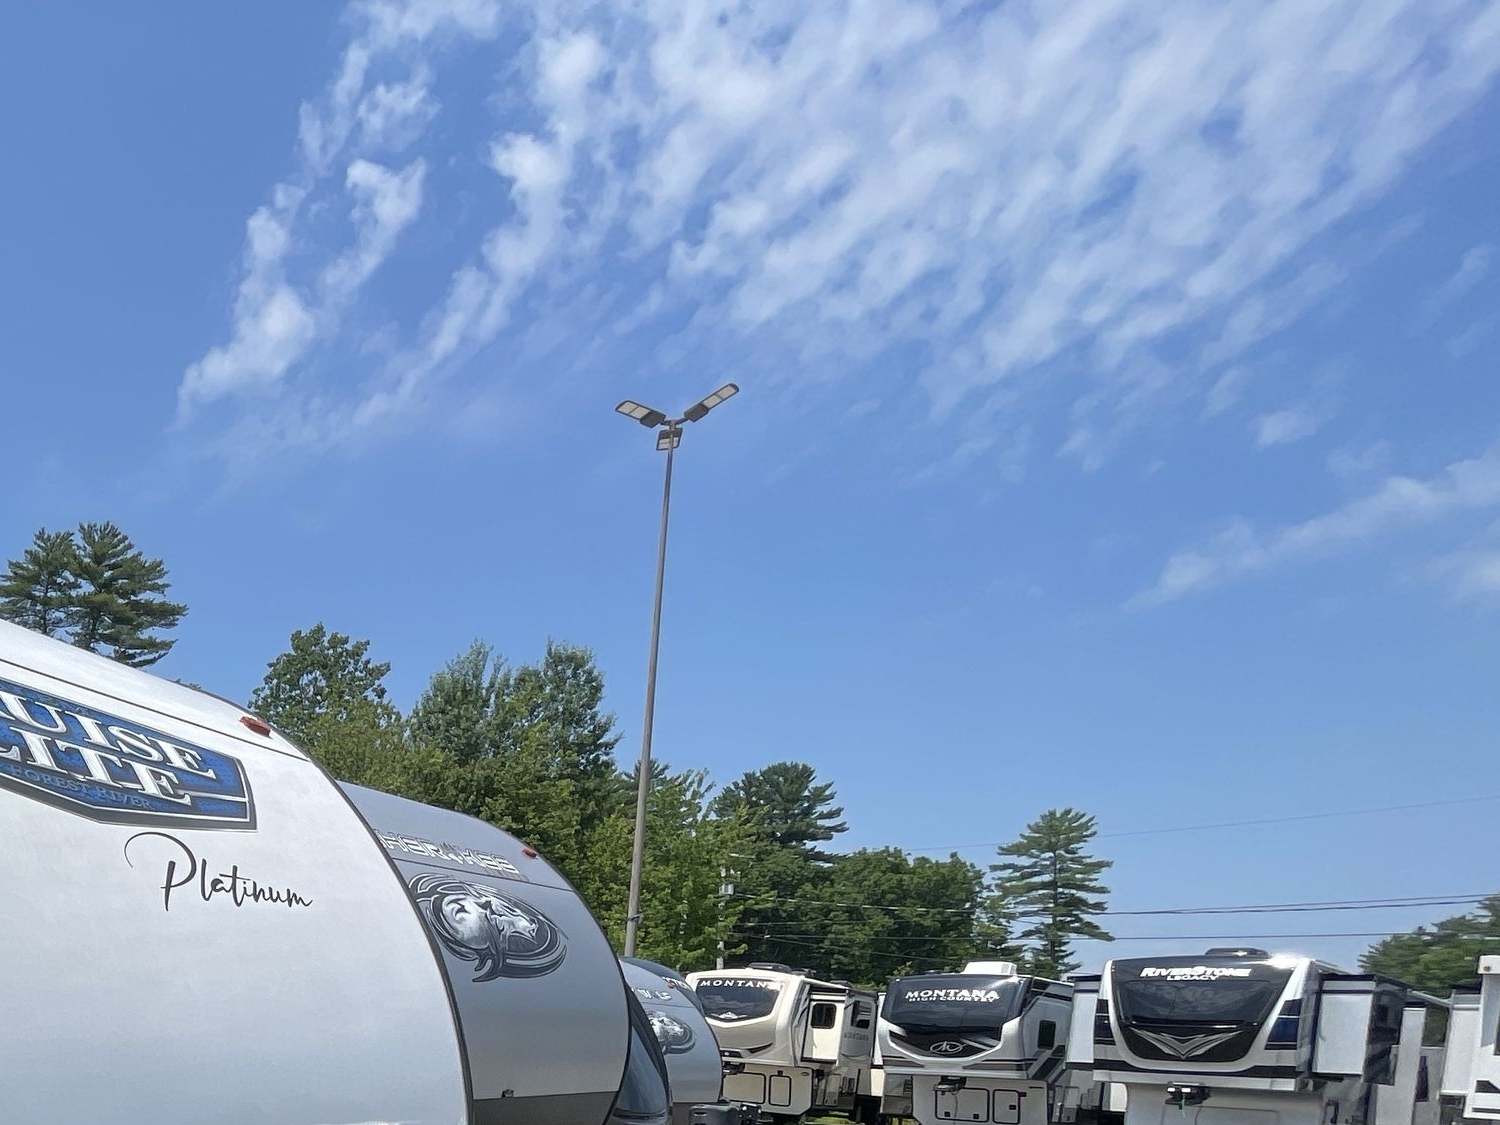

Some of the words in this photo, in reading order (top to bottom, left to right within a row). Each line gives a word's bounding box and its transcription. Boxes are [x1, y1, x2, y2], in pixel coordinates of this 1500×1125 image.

[8, 764, 91, 793] FOREST
[95, 785, 156, 811] RIVER
[123, 831, 314, 912] Platinum
[700, 979, 782, 991] MONTAN
[905, 989, 1000, 1000] MONTANA
